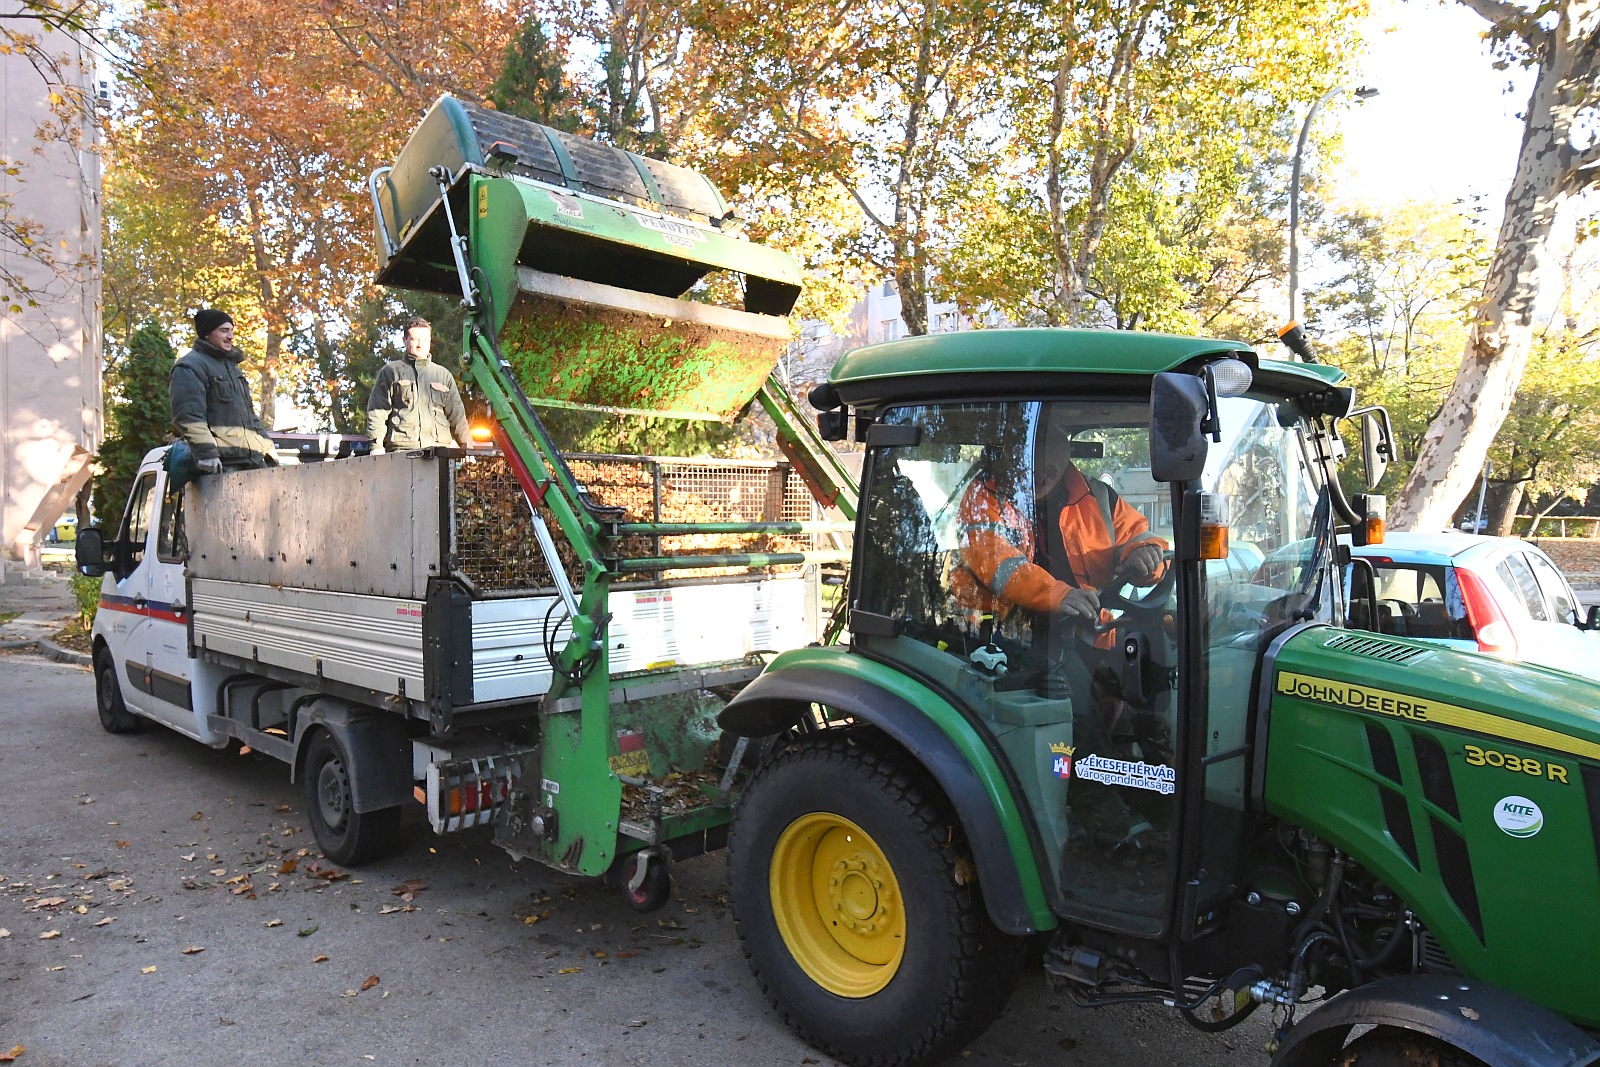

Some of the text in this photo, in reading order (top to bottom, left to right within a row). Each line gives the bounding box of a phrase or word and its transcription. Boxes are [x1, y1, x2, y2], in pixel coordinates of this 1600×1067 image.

[558, 206, 582, 217] KOALA
[552, 214, 596, 231] Professional
[640, 215, 701, 239] PERUZZO
[665, 235, 693, 248] 1500
[1285, 678, 1428, 720] JOHN DEERE
[1464, 744, 1569, 784] 3038 R
[1077, 766, 1175, 793] Városgondnoksága
[1503, 802, 1535, 816] KITE
